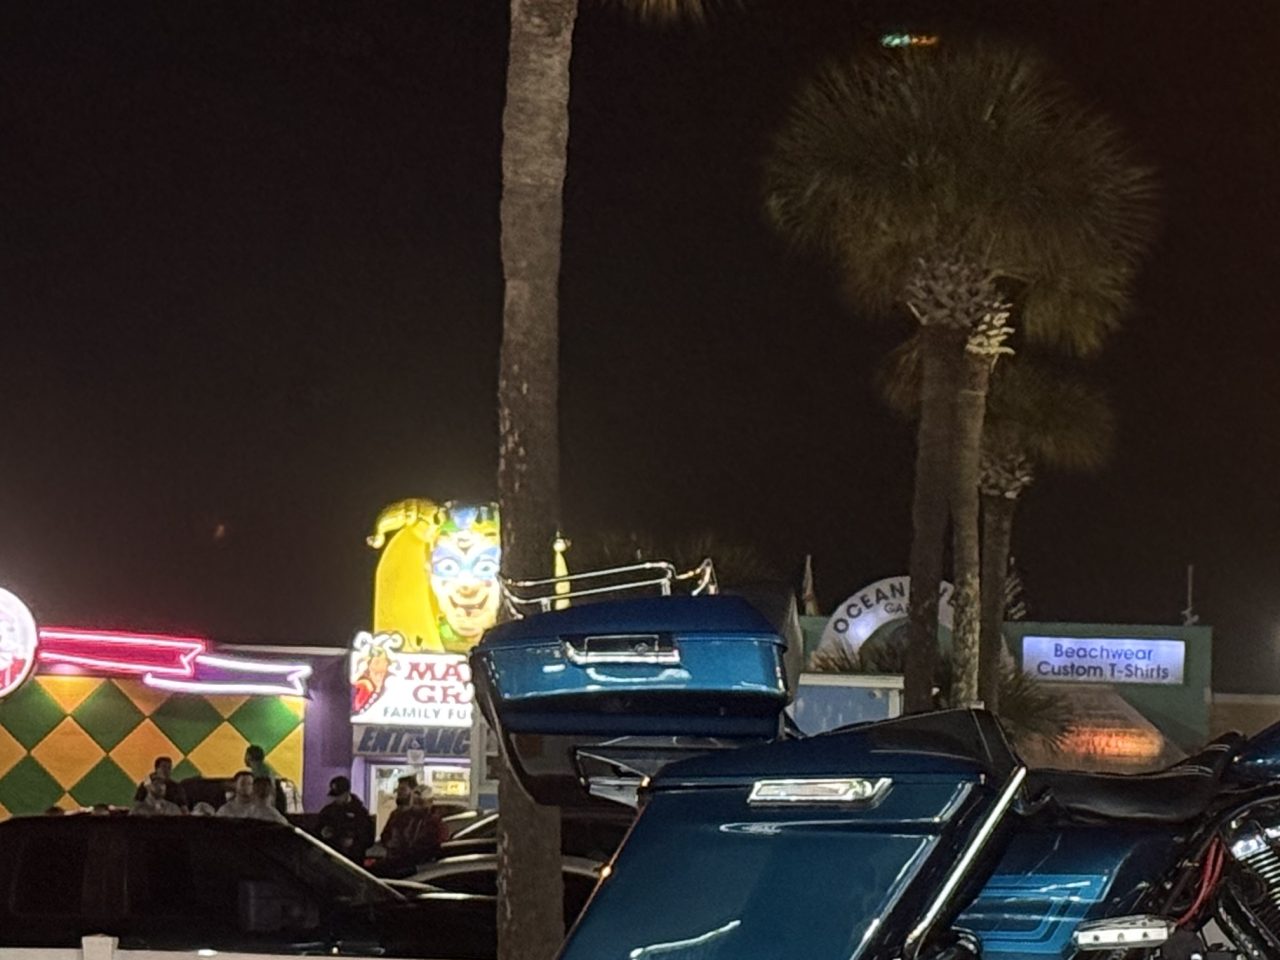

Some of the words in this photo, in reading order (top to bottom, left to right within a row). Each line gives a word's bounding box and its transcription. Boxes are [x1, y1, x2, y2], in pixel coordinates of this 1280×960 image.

[833, 582, 906, 634] OCEAN
[1053, 643, 1153, 661] Beachwear
[404, 661, 462, 682] MA
[1036, 660, 1104, 677] Custom
[1108, 662, 1170, 680] T-Shirts
[383, 706, 441, 720] FAMILY
